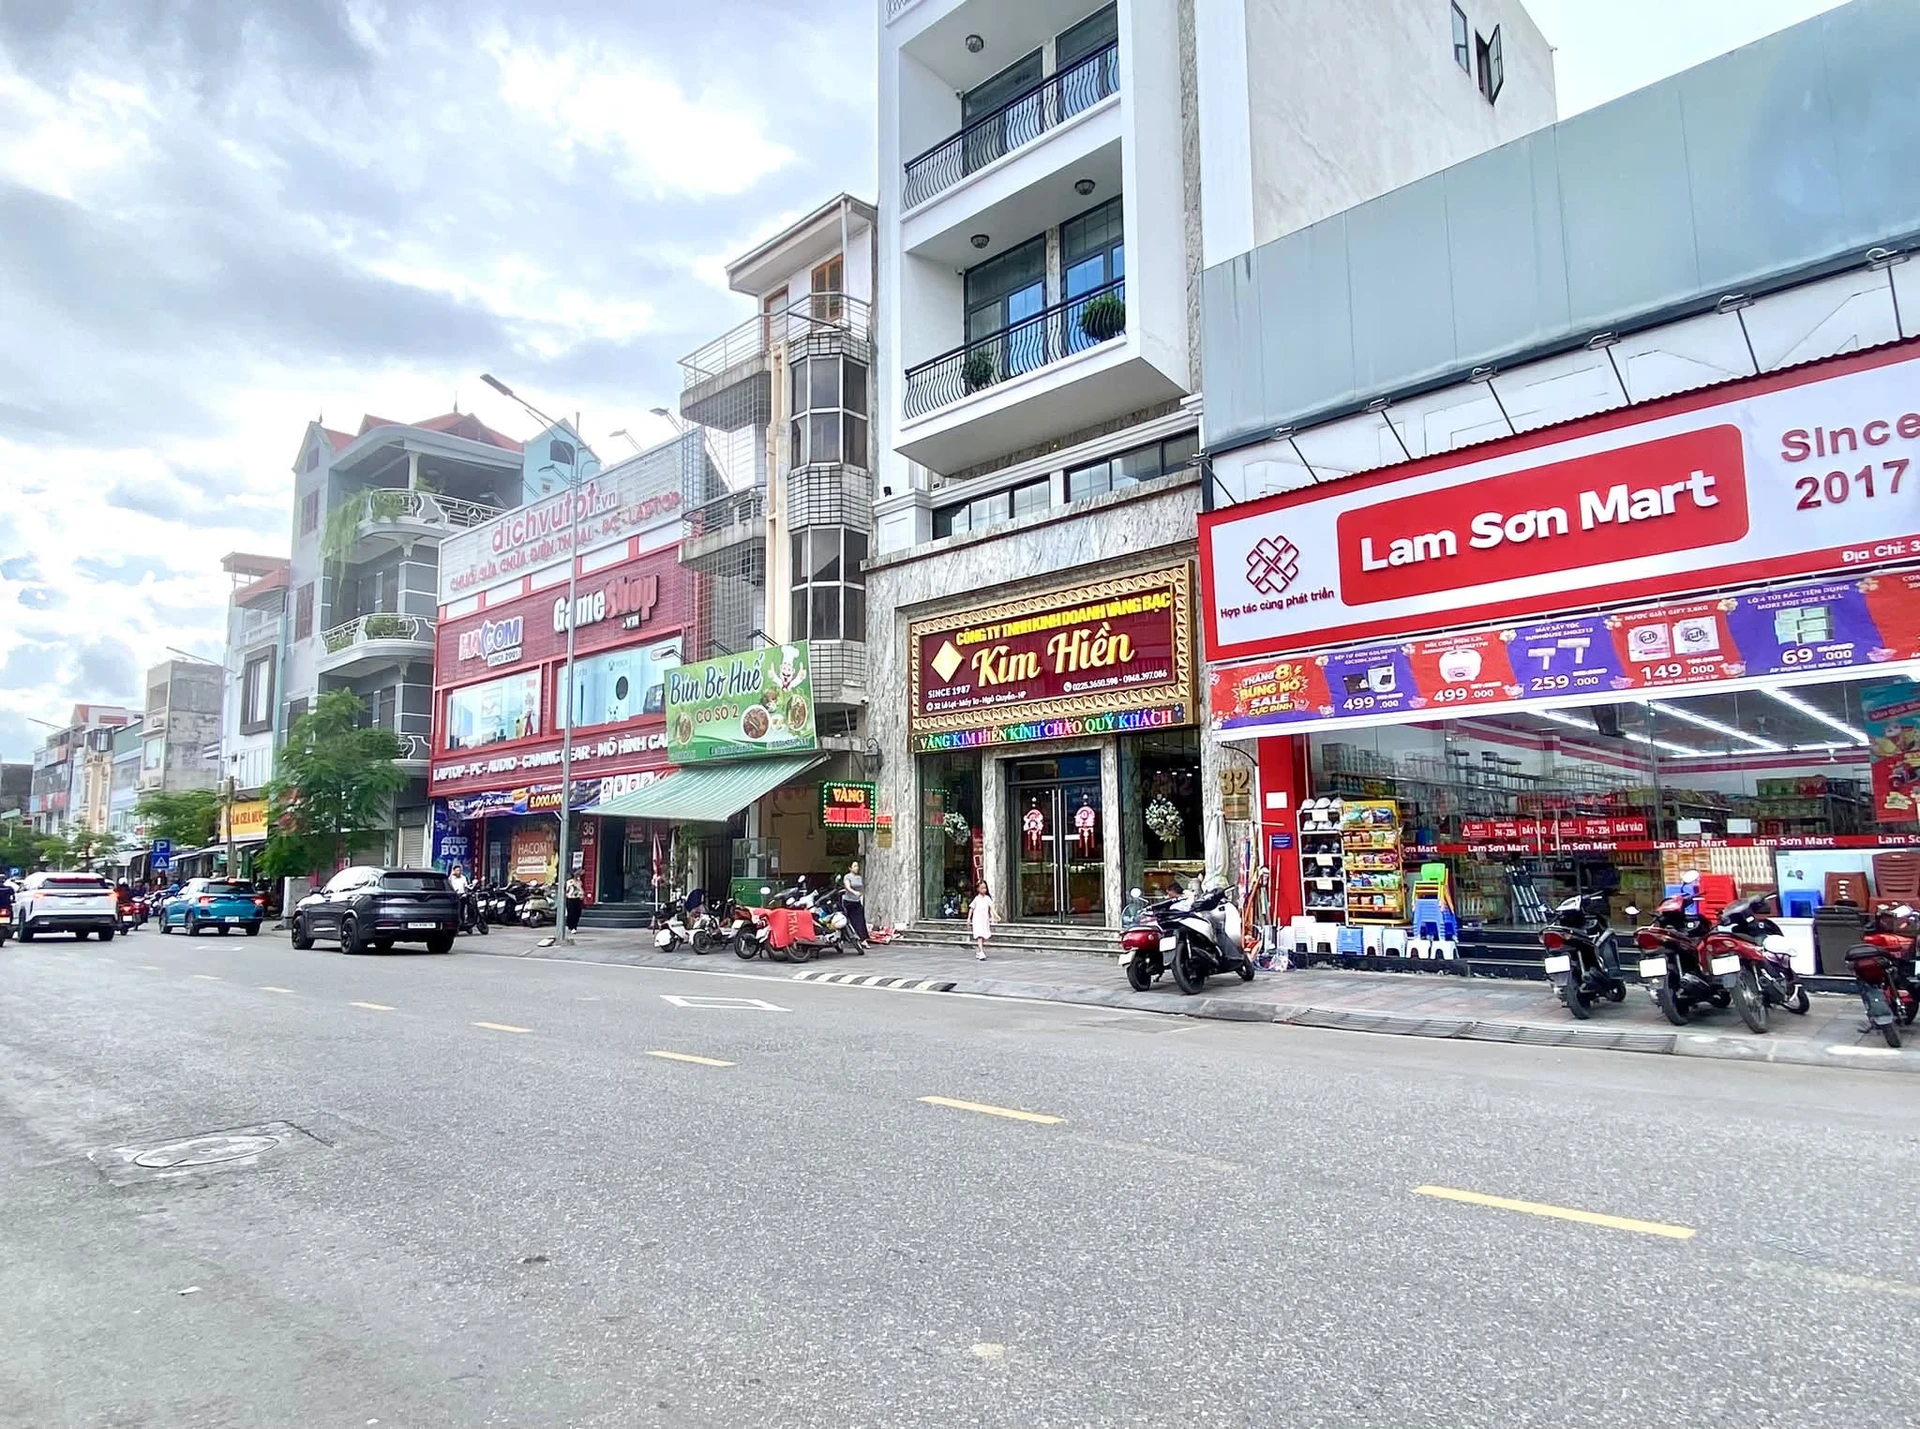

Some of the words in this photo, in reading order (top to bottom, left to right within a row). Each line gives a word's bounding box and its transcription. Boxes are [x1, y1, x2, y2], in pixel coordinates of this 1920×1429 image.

[1795, 458, 1910, 511] 2017
[1360, 527, 1458, 572] Lam
[1469, 504, 1569, 549] Sơn
[1578, 469, 1720, 532] Mart
[1842, 550, 1870, 563] Địa
[1220, 608, 1241, 619] Hợp
[1242, 602, 1258, 614] tác
[1259, 597, 1284, 611] cùng
[1286, 592, 1308, 608] phát
[1310, 587, 1335, 600] triển
[955, 627, 987, 646] CÔNG
[987, 626, 1000, 641] TY
[1062, 606, 1105, 626] DOANH
[1106, 597, 1142, 618] VÀNG
[1142, 591, 1171, 613] BẠC
[972, 644, 1043, 688] Kim
[1048, 622, 1136, 675] Hiền
[1782, 648, 1813, 665] 69
[670, 669, 701, 705] Bún
[705, 665, 724, 700] Bò
[729, 653, 765, 696] Huế
[1274, 663, 1291, 681] 8
[1641, 663, 1683, 680] 149
[1531, 675, 1570, 691] 259
[927, 687, 951, 699] SINCE
[951, 684, 971, 696] 1987
[1433, 687, 1468, 702] 499
[1250, 693, 1291, 709] SALE
[1343, 696, 1375, 710] 499
[732, 704, 739, 720] 2
[920, 732, 951, 750] VÀNG
[952, 730, 976, 746] KIM
[1044, 719, 1082, 738] CHÀO
[1085, 715, 1115, 734] QUÝ
[1118, 709, 1173, 729] KHÁCH
[433, 764, 465, 782] LAPTOP
[470, 761, 482, 777] PC
[487, 756, 517, 775] AUDIO
[522, 750, 561, 769] GAMING
[598, 739, 617, 758] MÔ
[618, 734, 647, 753] HÌNH
[1221, 768, 1250, 796] 32
[832, 786, 865, 803] VÀNG
[583, 822, 595, 836] 36
[156, 841, 167, 852] P
[1467, 844, 1487, 852] Lam
[1488, 844, 1505, 852] Sơn
[1507, 843, 1529, 852] Mart
[1572, 841, 1591, 851] Sơn
[1593, 841, 1618, 850] Mart
[1653, 840, 1676, 849] Lam
[1678, 839, 1699, 848] Sơn
[1701, 838, 1728, 848] Mart
[1752, 837, 1776, 847] Lam
[1779, 836, 1802, 846] Sơn
[1804, 836, 1834, 846] Mart
[1877, 834, 1906, 845] Lam
[518, 842, 547, 855] HACOM
[1417, 845, 1438, 853] Mart
